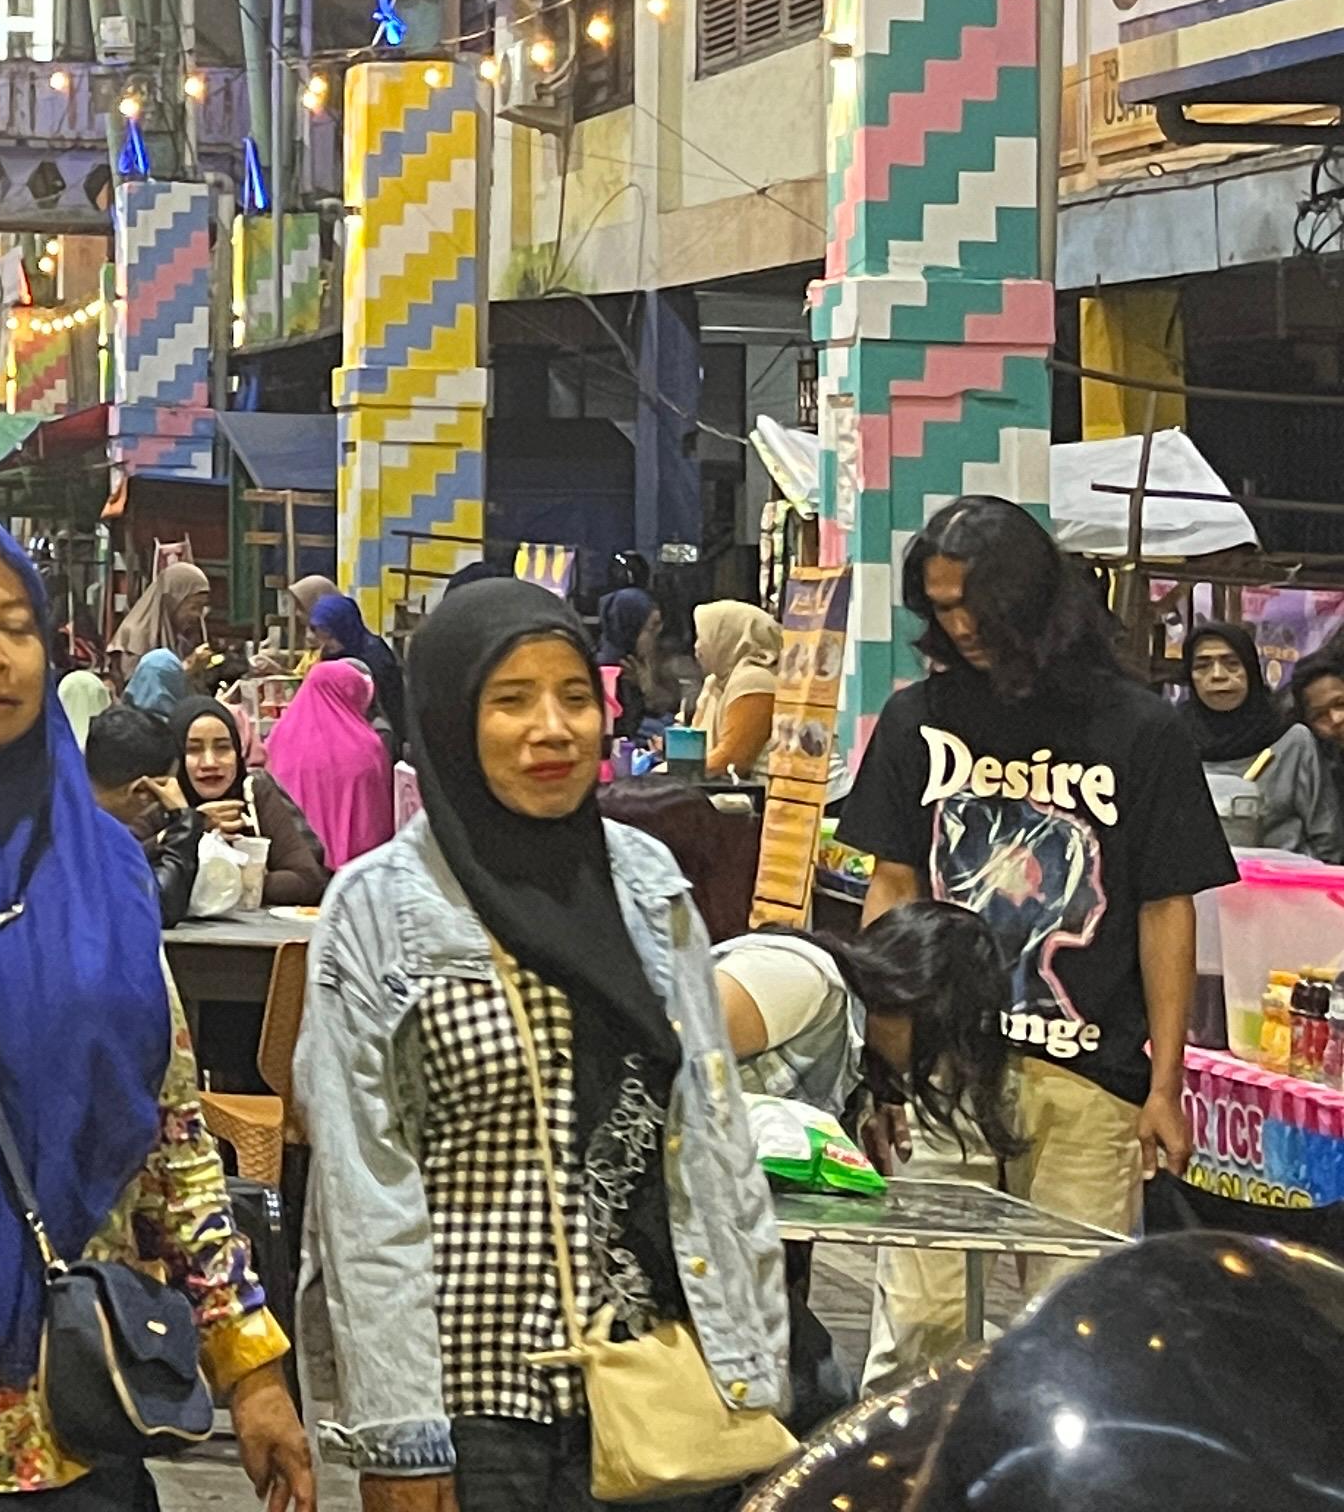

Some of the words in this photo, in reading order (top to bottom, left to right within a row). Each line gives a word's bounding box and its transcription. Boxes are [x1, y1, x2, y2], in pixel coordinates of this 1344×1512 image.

[920, 725, 1118, 826] Desire
[1000, 1010, 1101, 1058] nge
[1215, 1099, 1265, 1170] ICE
